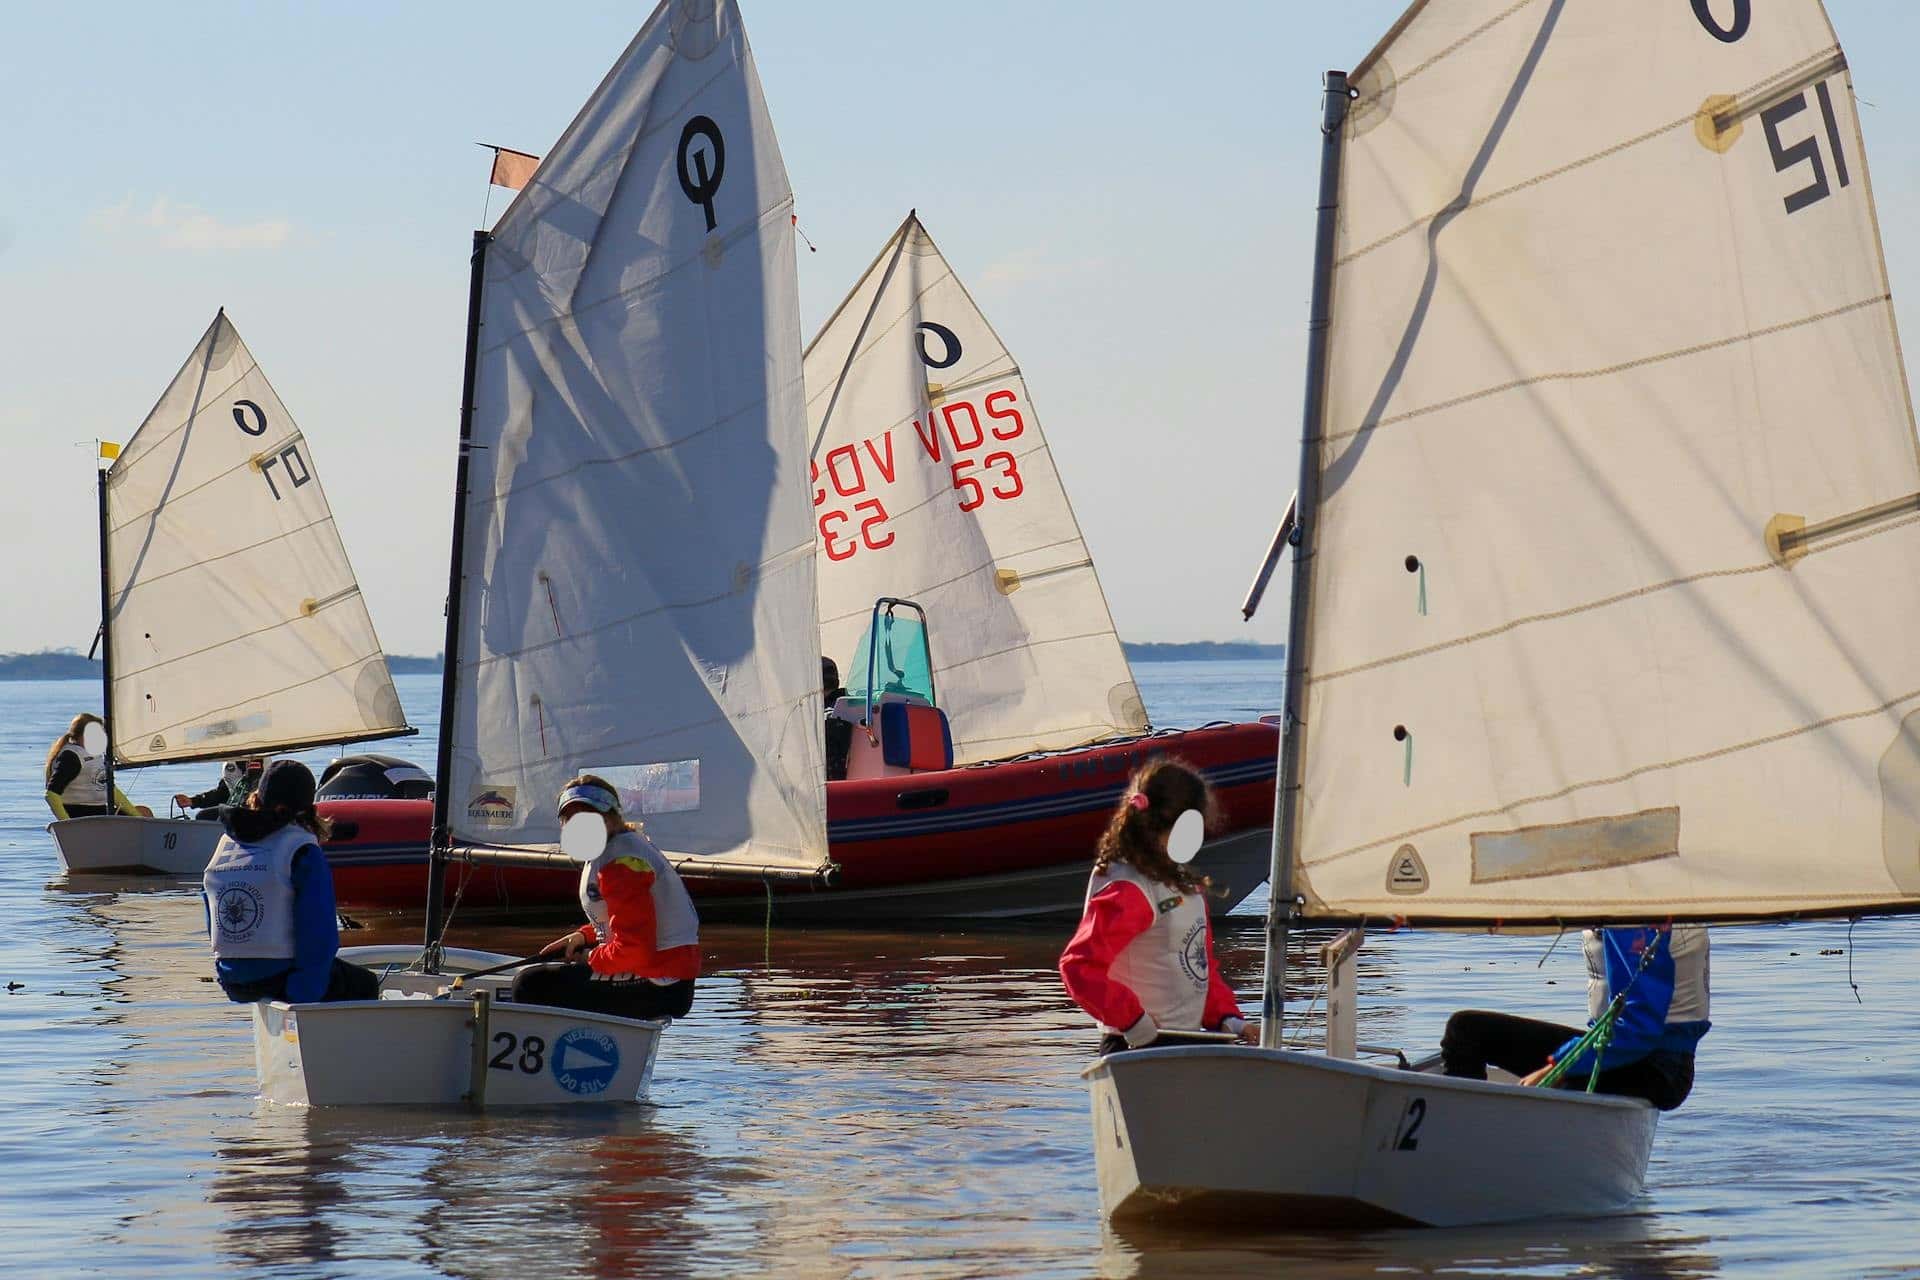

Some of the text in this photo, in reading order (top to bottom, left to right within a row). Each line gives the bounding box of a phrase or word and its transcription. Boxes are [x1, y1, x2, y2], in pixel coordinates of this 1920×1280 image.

[913, 390, 1024, 463] VDS
[950, 451, 1024, 513] 53
[163, 831, 177, 849] 10
[488, 1032, 546, 1075] 28
[560, 1073, 607, 1093] DO SUL
